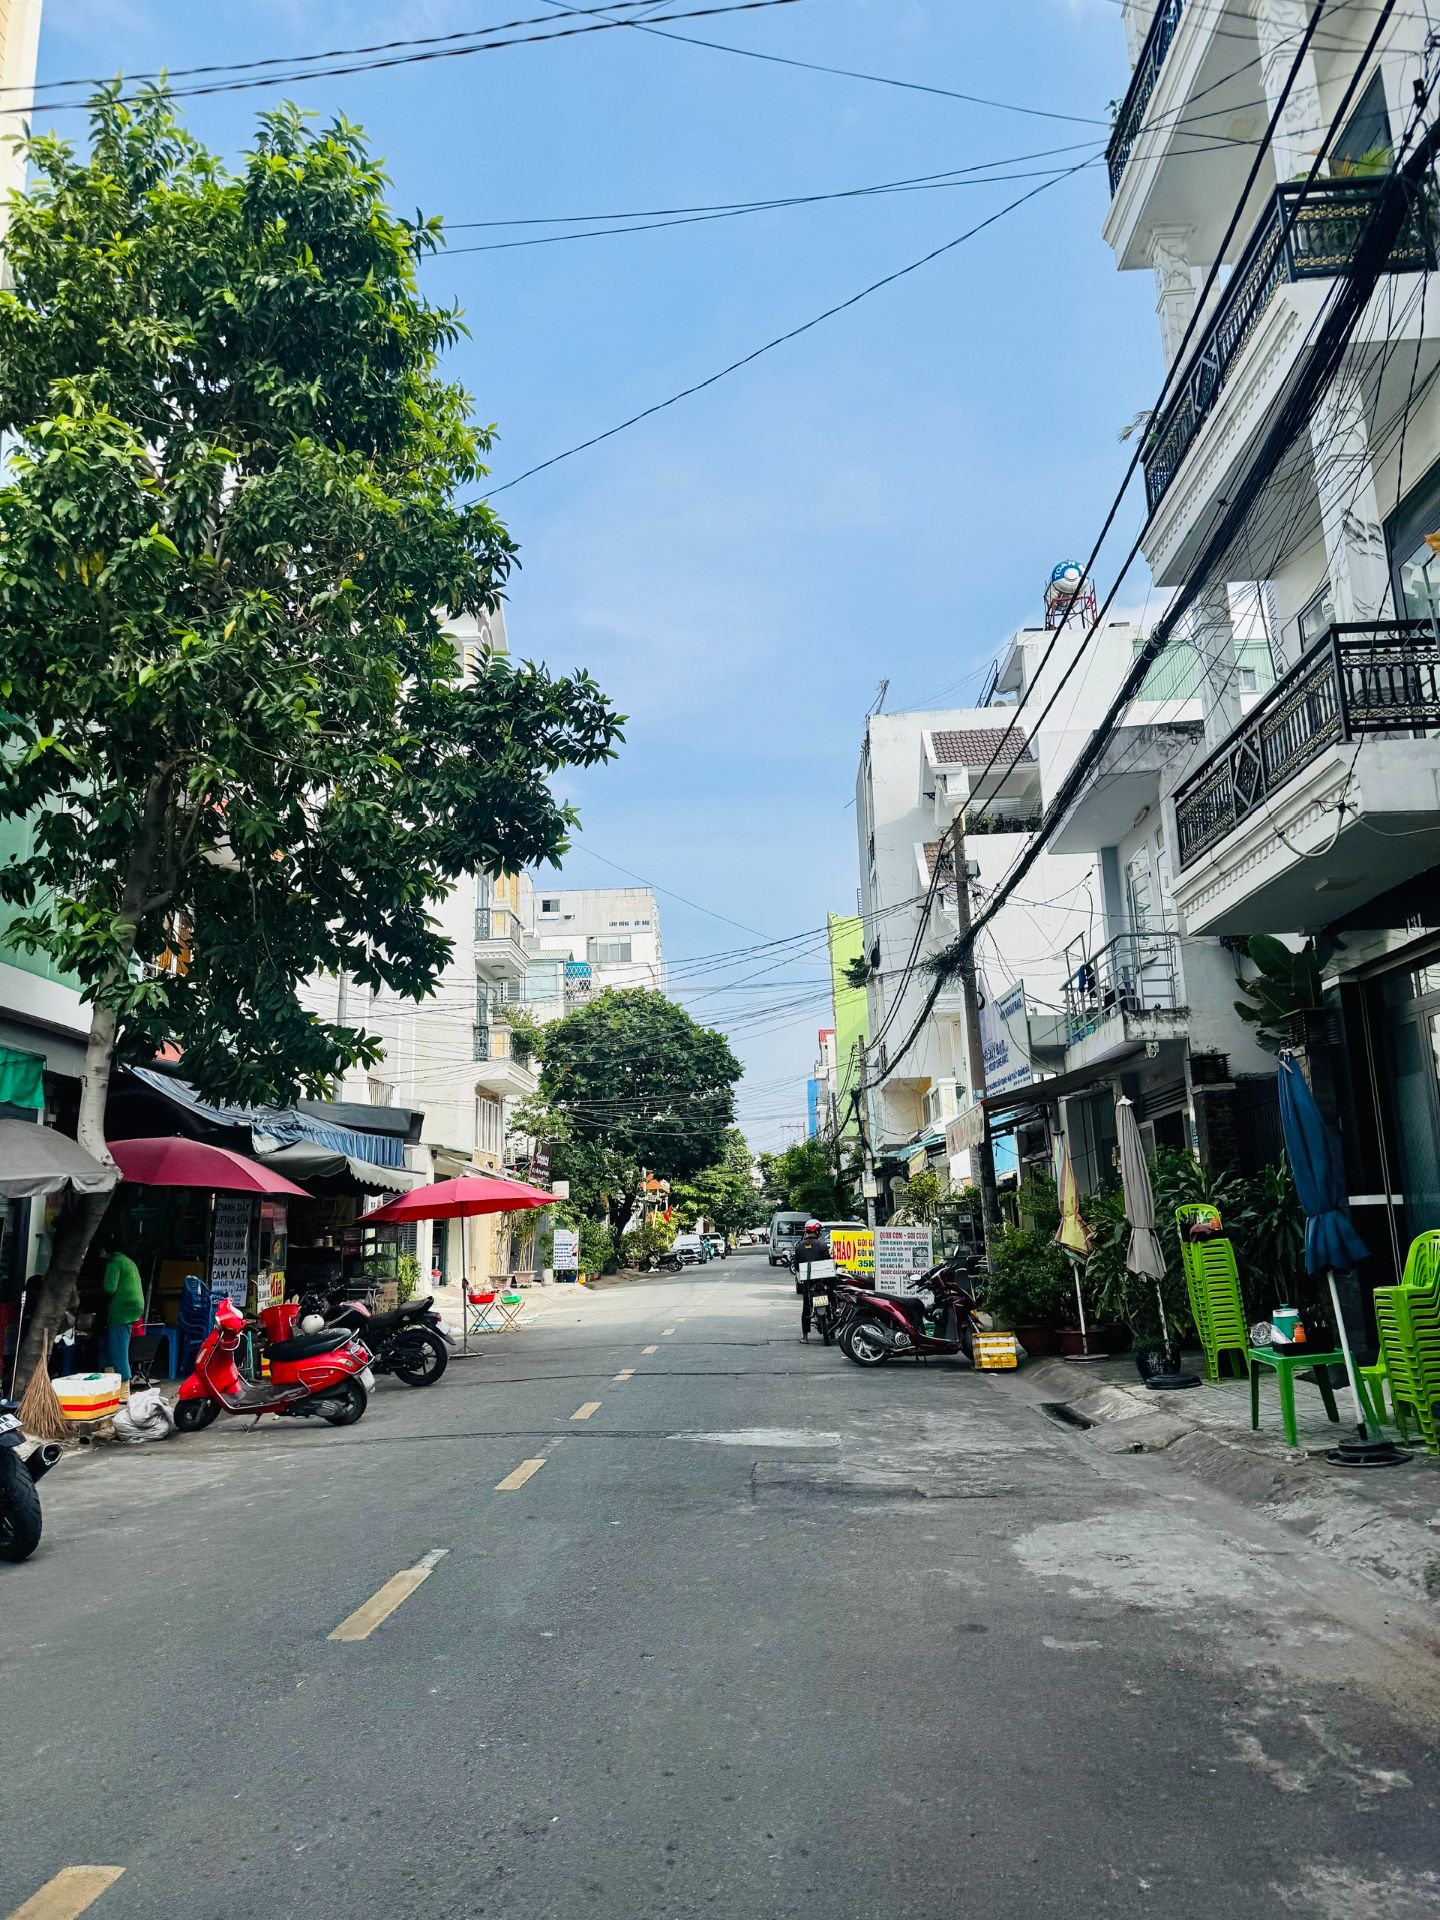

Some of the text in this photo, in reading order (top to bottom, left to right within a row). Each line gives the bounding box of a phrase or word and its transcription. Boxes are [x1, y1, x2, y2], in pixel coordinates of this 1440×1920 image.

[1406, 912, 1422, 928] 131
[832, 1236, 851, 1260] CHÁO
[213, 1257, 230, 1267] RAU
[858, 1259, 875, 1268] 35K
[213, 1270, 228, 1280] CAM
